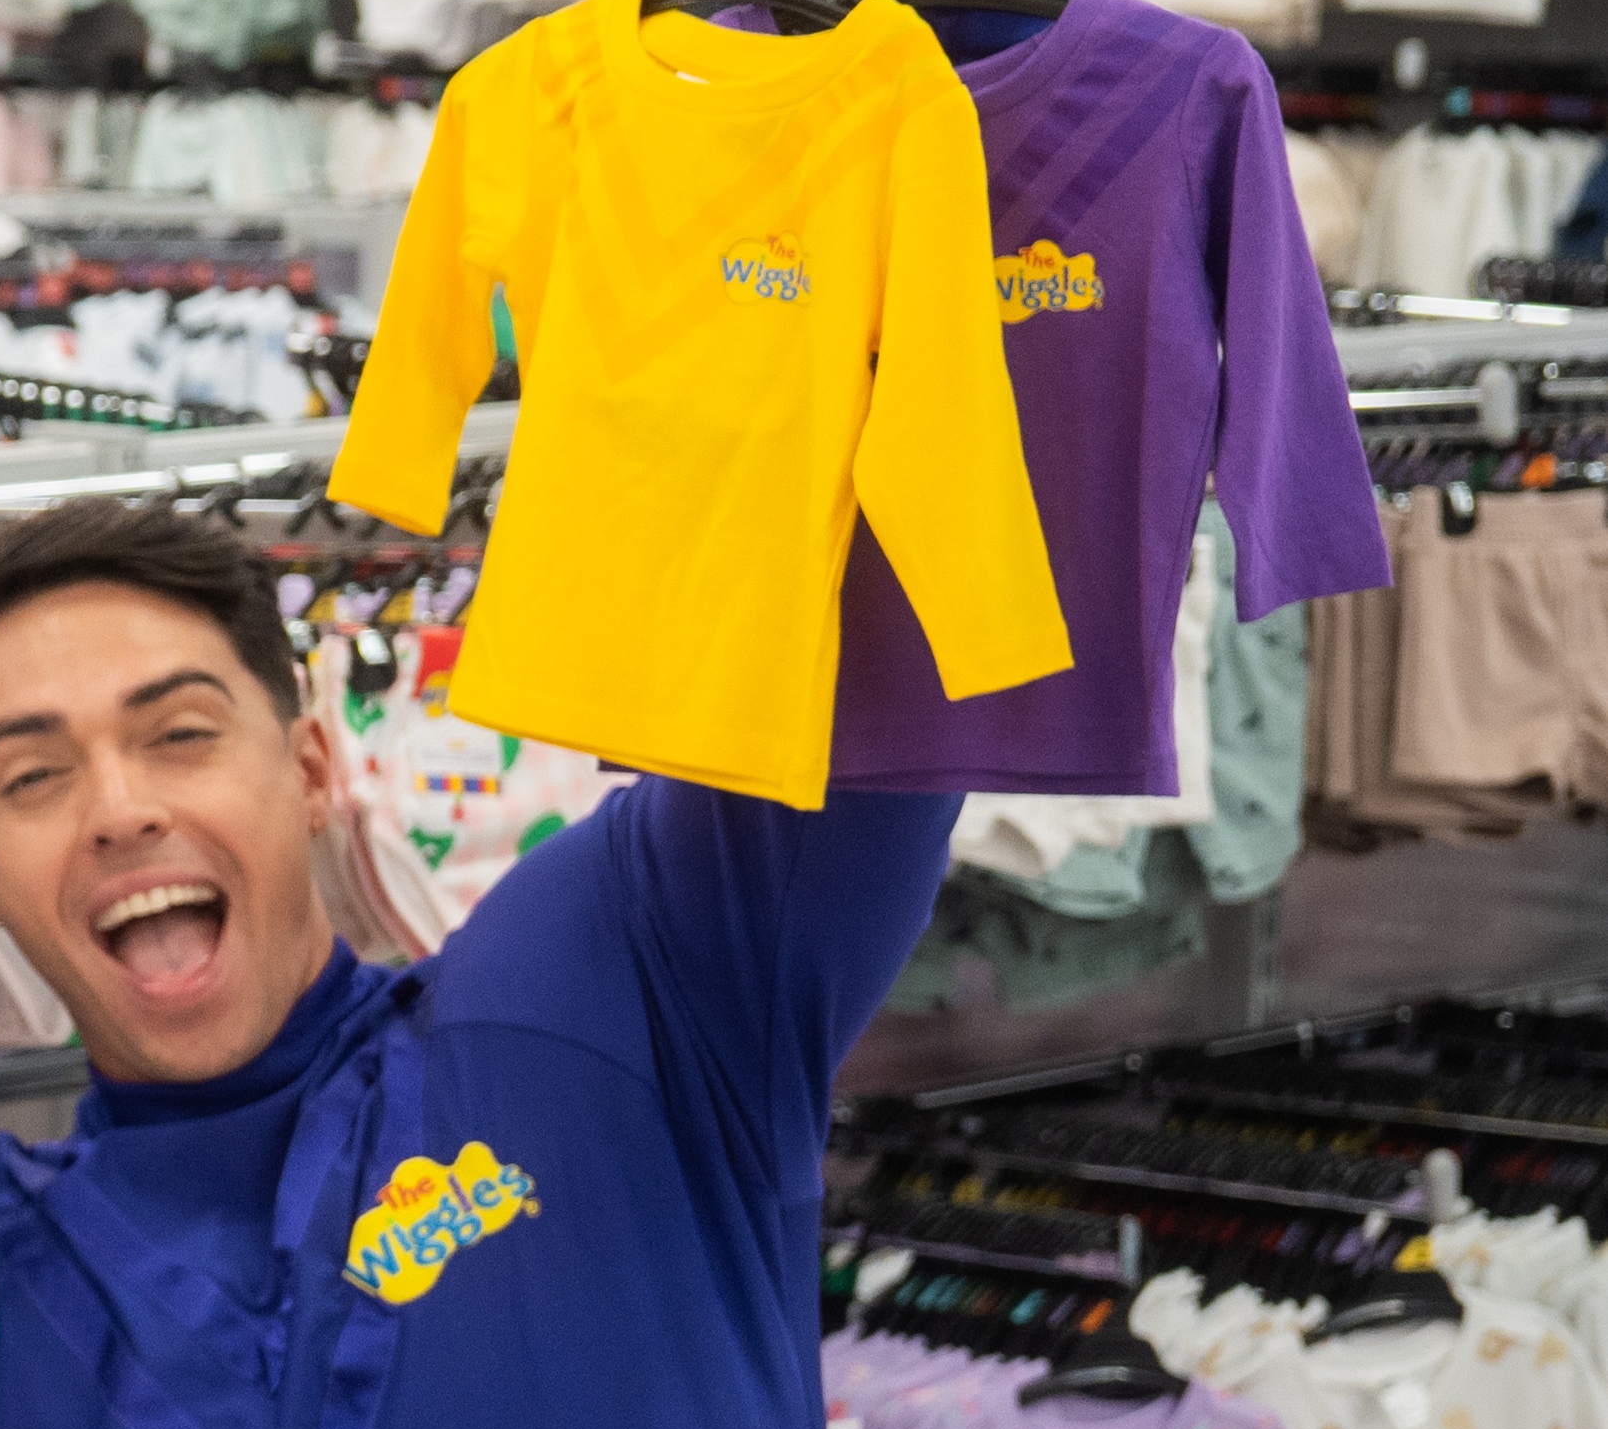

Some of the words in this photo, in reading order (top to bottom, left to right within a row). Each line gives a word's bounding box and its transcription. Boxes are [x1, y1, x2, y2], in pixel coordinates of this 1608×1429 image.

[768, 235, 796, 260] The
[1020, 246, 1056, 270] The
[722, 255, 812, 302] Wiggle
[376, 1175, 436, 1212] The
[344, 1164, 533, 1291] Wiggles
